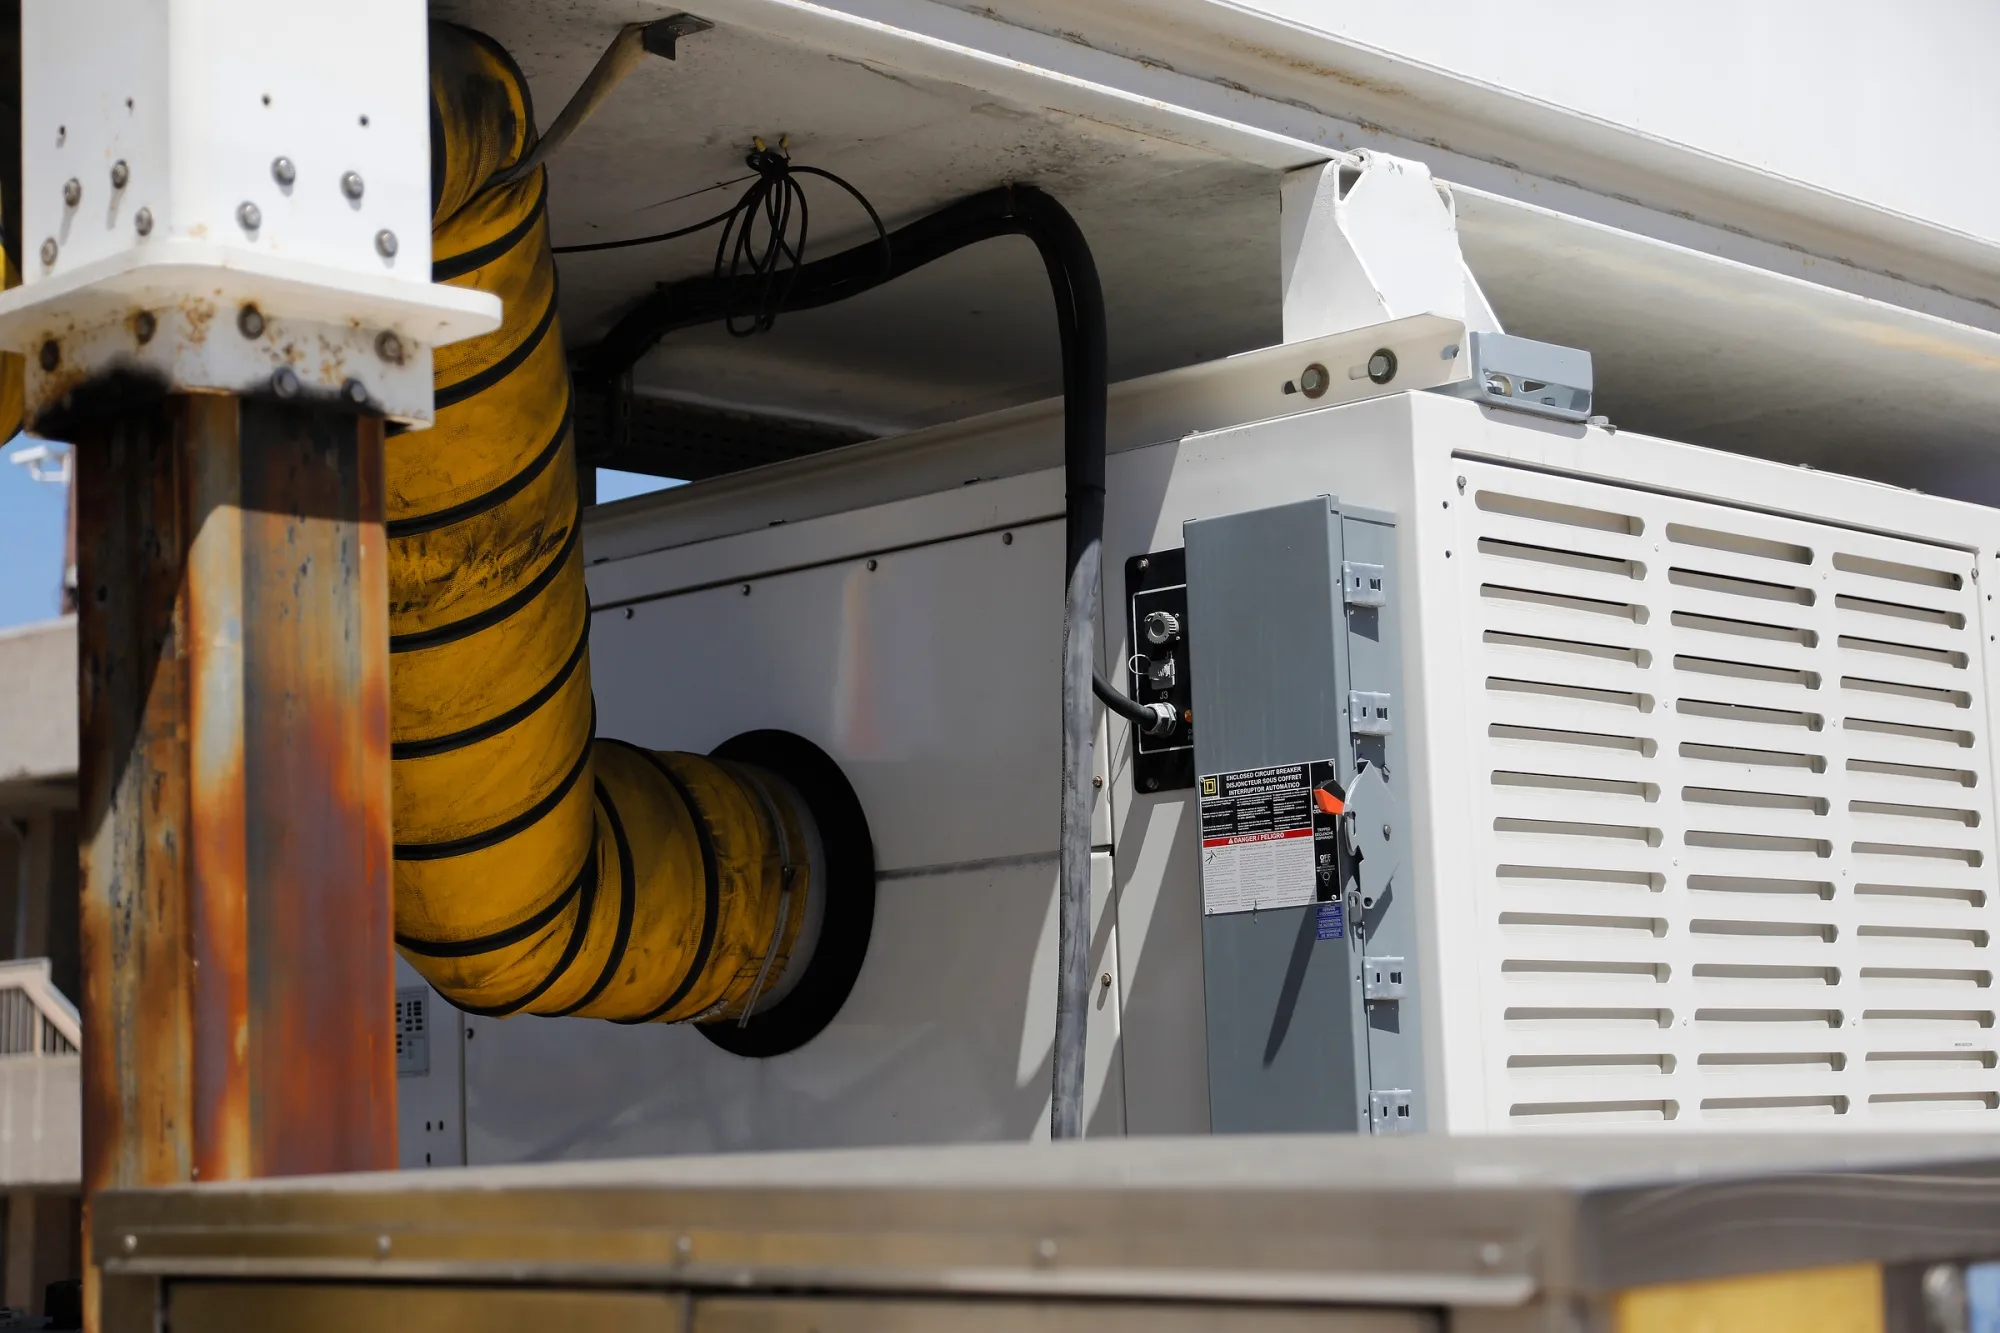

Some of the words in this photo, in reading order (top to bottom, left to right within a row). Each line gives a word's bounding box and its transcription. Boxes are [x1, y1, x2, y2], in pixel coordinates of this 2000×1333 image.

[1160, 690, 1169, 700] J3
[1226, 772, 1254, 781] ENCLOSED
[1254, 769, 1275, 777] CIRCUIT
[1276, 766, 1302, 775] BREAKER
[1226, 779, 1262, 789] DISJONCTEUR
[1278, 773, 1303, 782] COFFRET
[1229, 786, 1265, 796] INTERRUPTOR
[1265, 782, 1300, 791] AUTOMÁTICO
[1233, 835, 1257, 843] DANGER
[1260, 832, 1285, 841] PELIGRO
